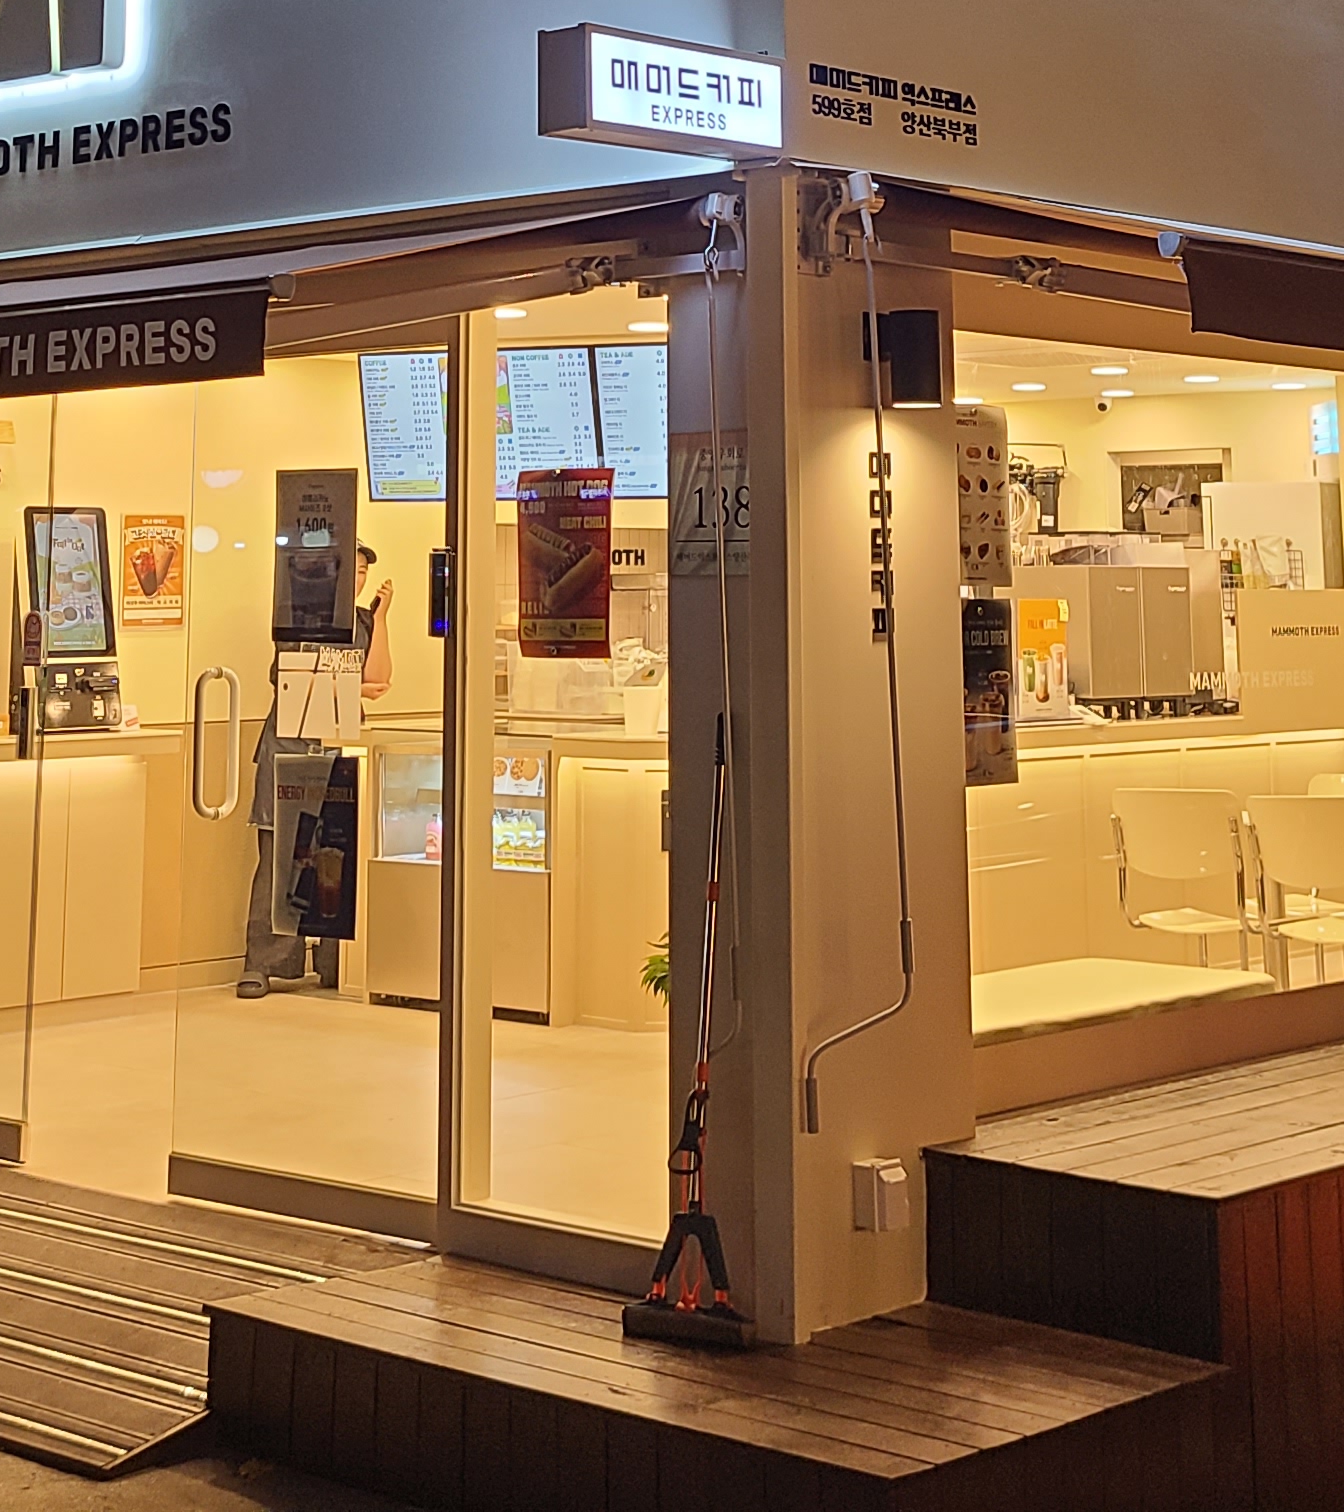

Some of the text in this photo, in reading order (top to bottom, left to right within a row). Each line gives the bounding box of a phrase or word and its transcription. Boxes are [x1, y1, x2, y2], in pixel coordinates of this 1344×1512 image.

[610, 58, 763, 108] 매머드커피
[901, 82, 977, 116] 익스프레스
[651, 104, 727, 131] EXPRESS
[811, 94, 978, 146] 599호점 양산북부점
[72, 103, 232, 165] EXPRESS
[47, 316, 217, 374] EXPRESS
[564, 480, 585, 497] HOT
[694, 485, 750, 529] 138
[971, 629, 989, 646] COLD
[990, 629, 1009, 646] BREW
[1271, 626, 1340, 637] MAMMOTH EXPRESS
[1189, 669, 1314, 691] MAMMOTH EXPRESS
[278, 785, 305, 800] ENERGY
